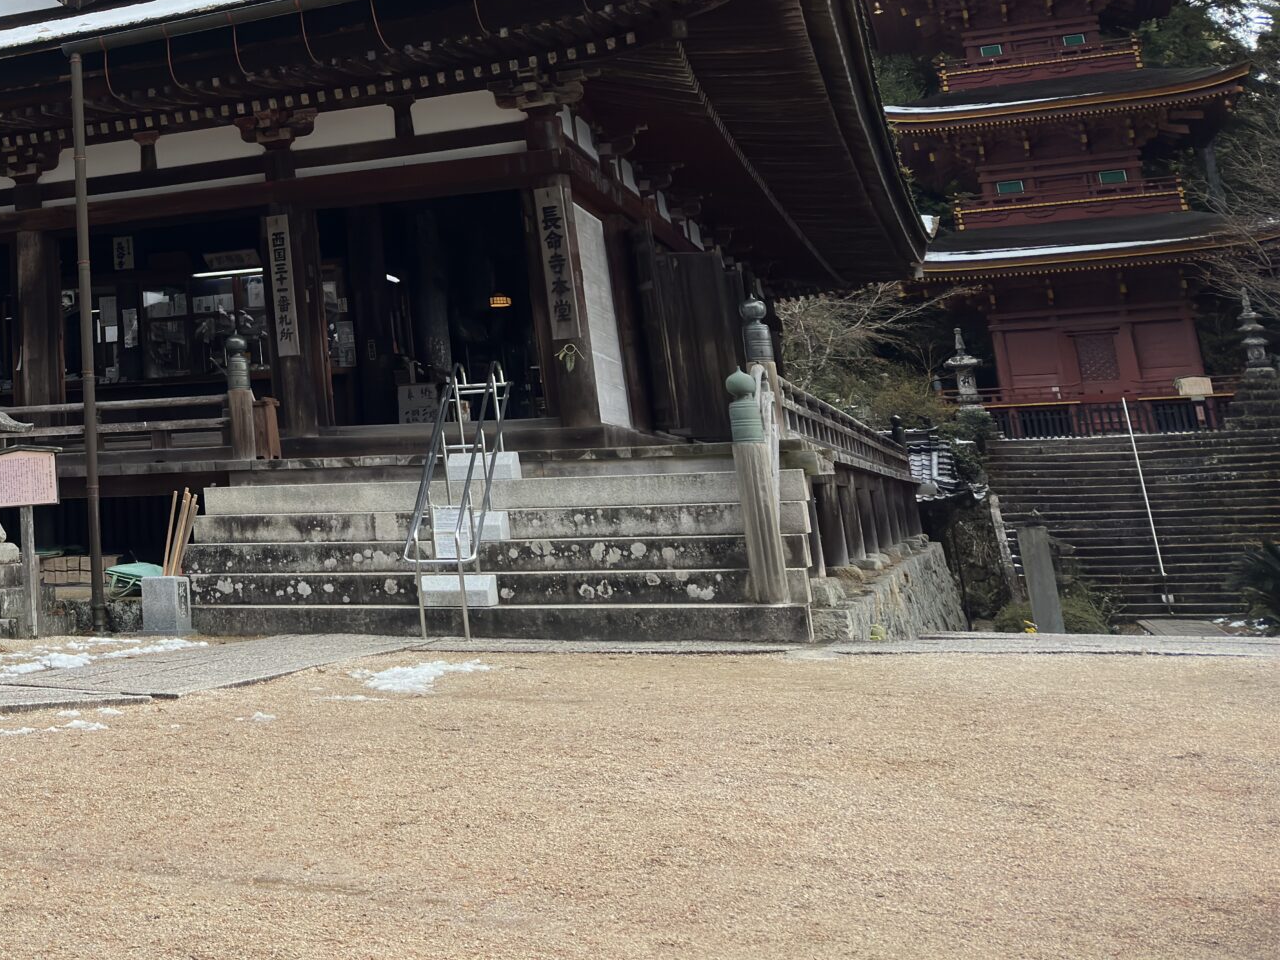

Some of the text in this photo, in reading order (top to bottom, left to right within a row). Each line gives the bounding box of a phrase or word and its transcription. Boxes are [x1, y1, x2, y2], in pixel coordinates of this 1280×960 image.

[272, 231, 294, 342] 西国三十一番札所
[542, 205, 571, 322] 長命寺本堂
